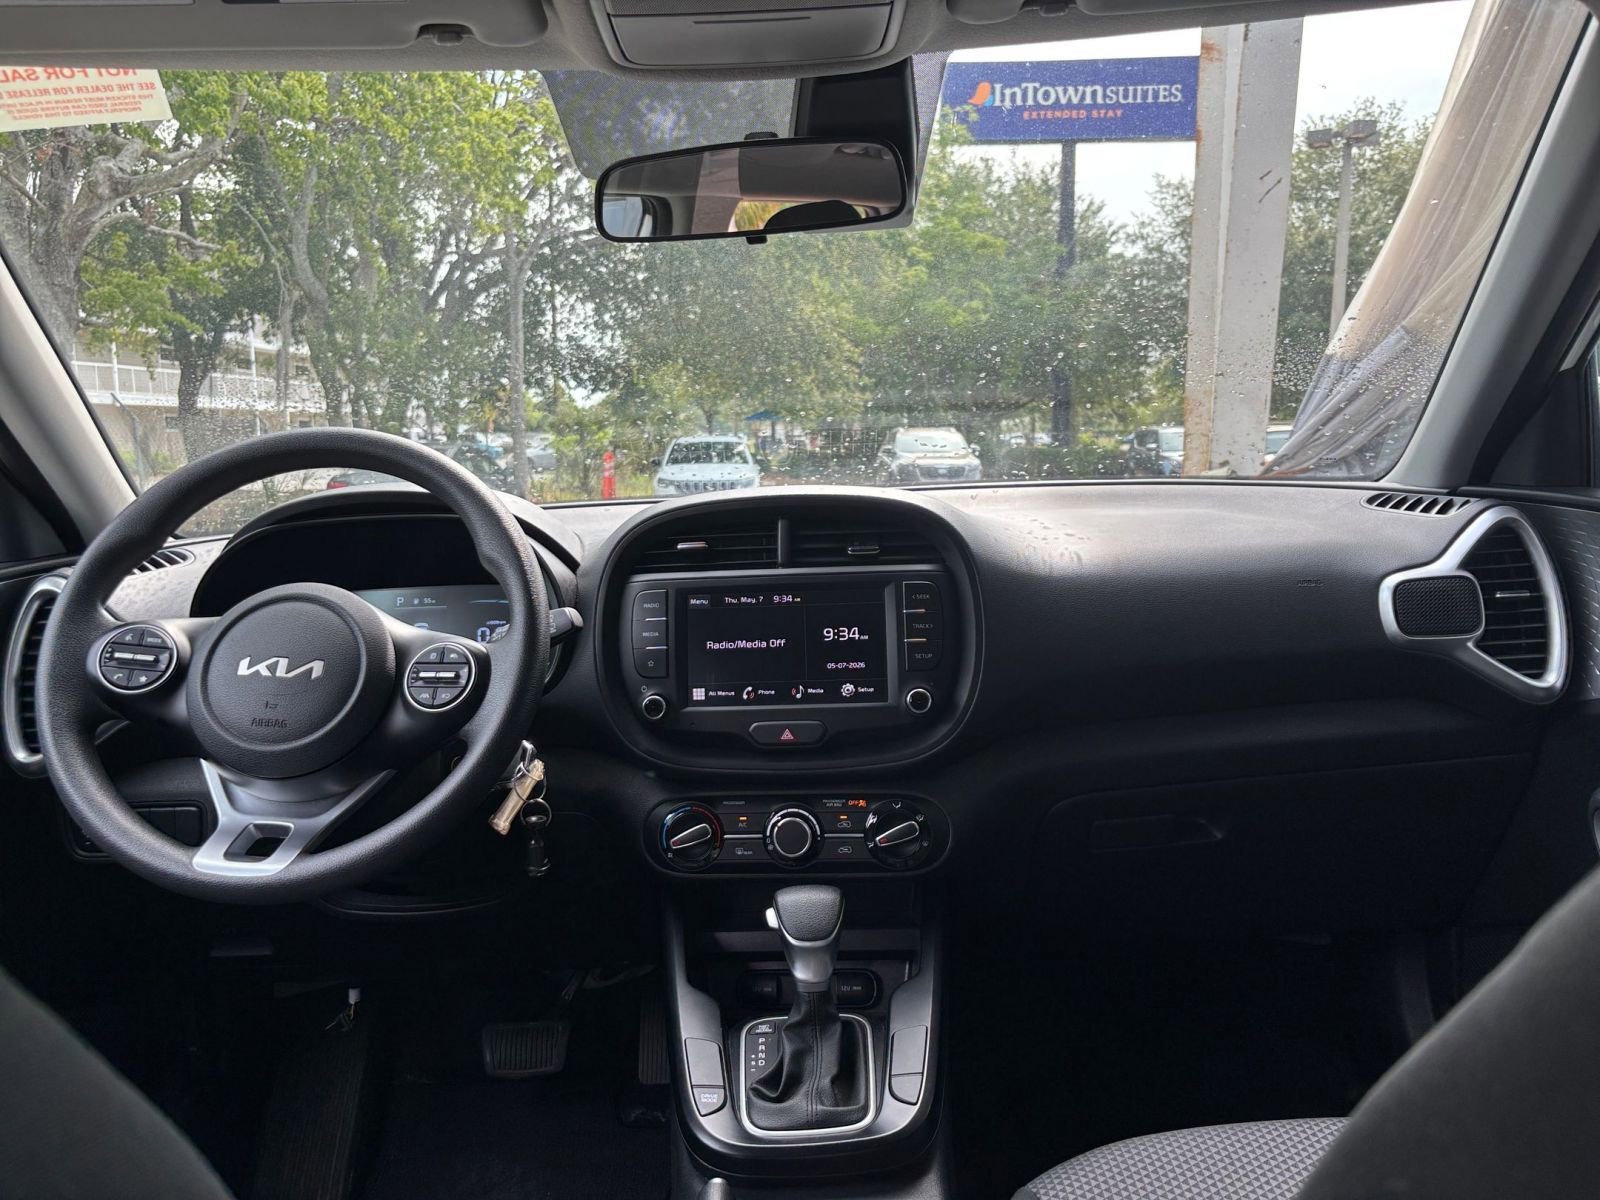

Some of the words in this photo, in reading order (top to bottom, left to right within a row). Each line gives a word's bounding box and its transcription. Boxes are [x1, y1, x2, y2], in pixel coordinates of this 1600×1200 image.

[1023, 110, 1086, 120] EXTENDED
[1091, 109, 1124, 119] STAY
[396, 597, 404, 606] P
[773, 595, 793, 603] 9:34
[823, 627, 859, 641] 9:34
[706, 640, 767, 650] Radio/Media
[769, 639, 786, 648] Off
[250, 717, 288, 728] AIRBAG
